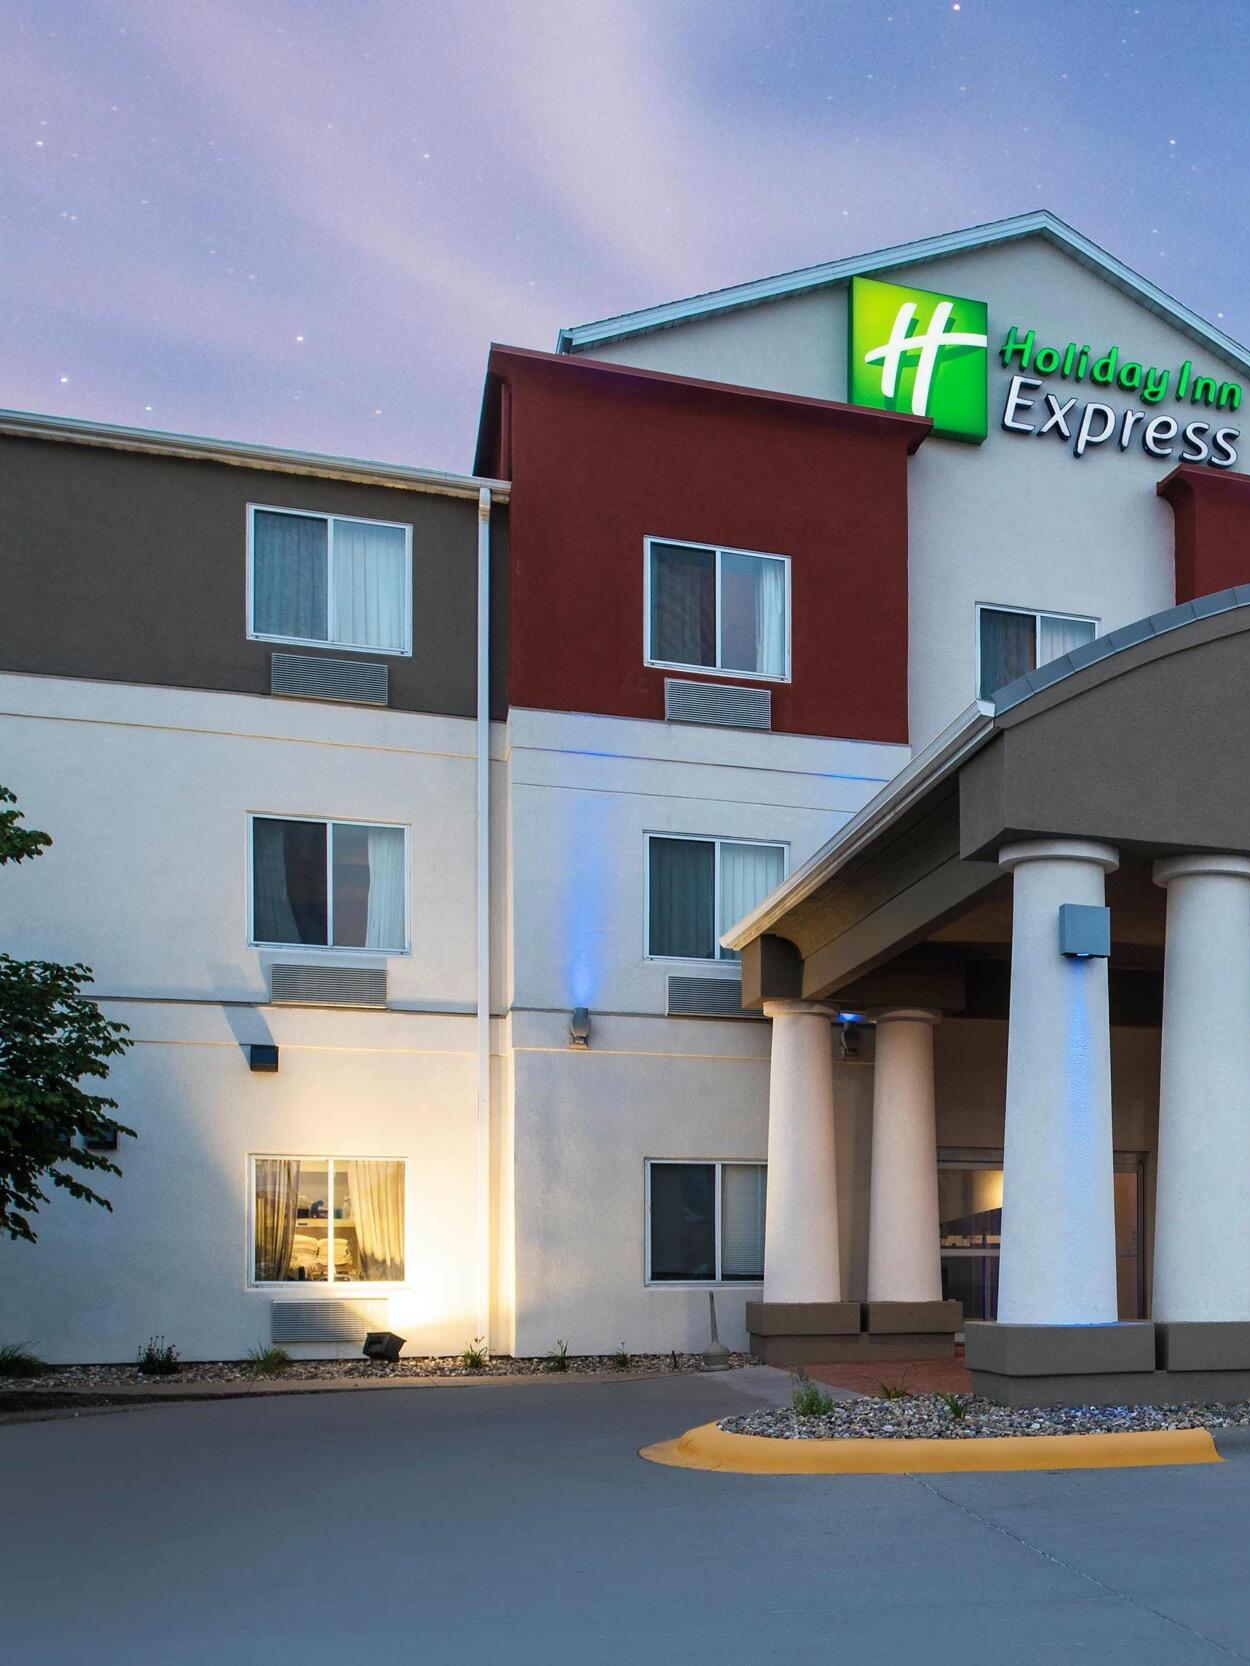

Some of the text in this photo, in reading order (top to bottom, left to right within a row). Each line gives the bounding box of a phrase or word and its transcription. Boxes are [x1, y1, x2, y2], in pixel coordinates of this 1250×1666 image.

[1000, 326, 1243, 412] Holiday Inn
[1001, 375, 1241, 469] Express
